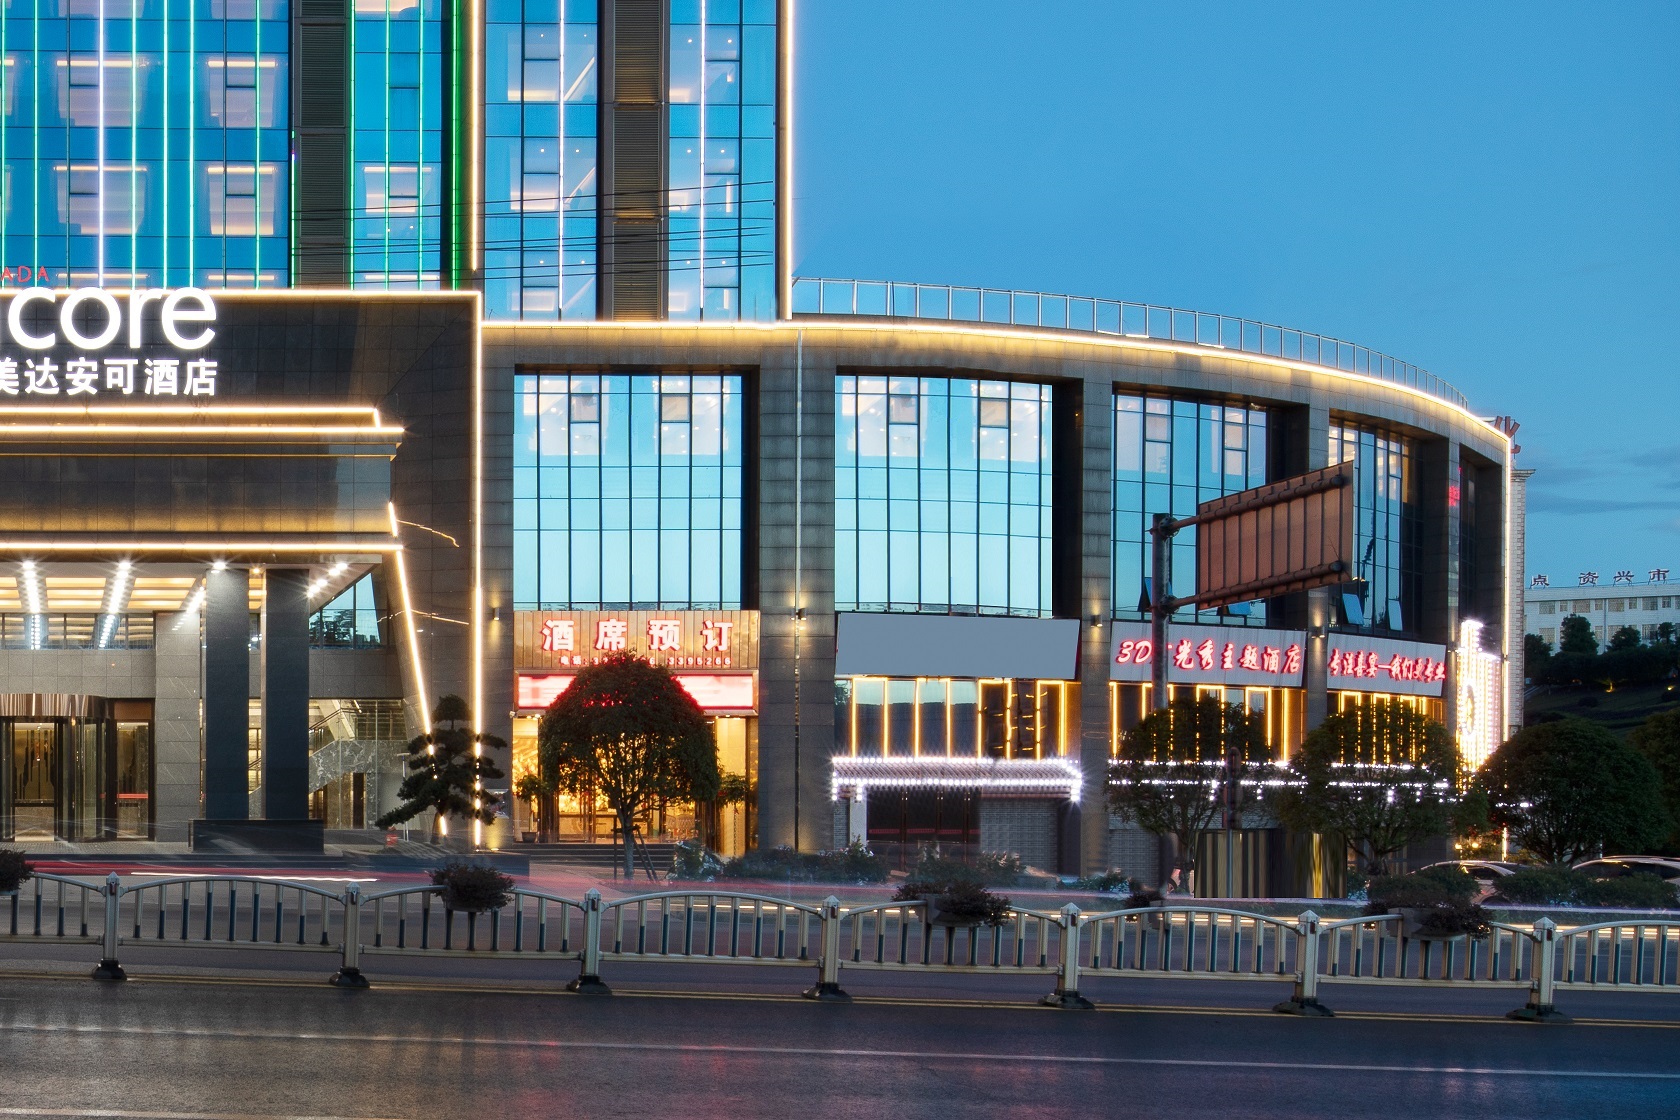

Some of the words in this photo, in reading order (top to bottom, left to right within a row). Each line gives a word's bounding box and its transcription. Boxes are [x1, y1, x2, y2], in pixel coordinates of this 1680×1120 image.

[1578, 568, 1670, 586] 资兴市
[541, 618, 734, 652] 酒席预订
[1116, 637, 1302, 675] 3D光秀主题酒店
